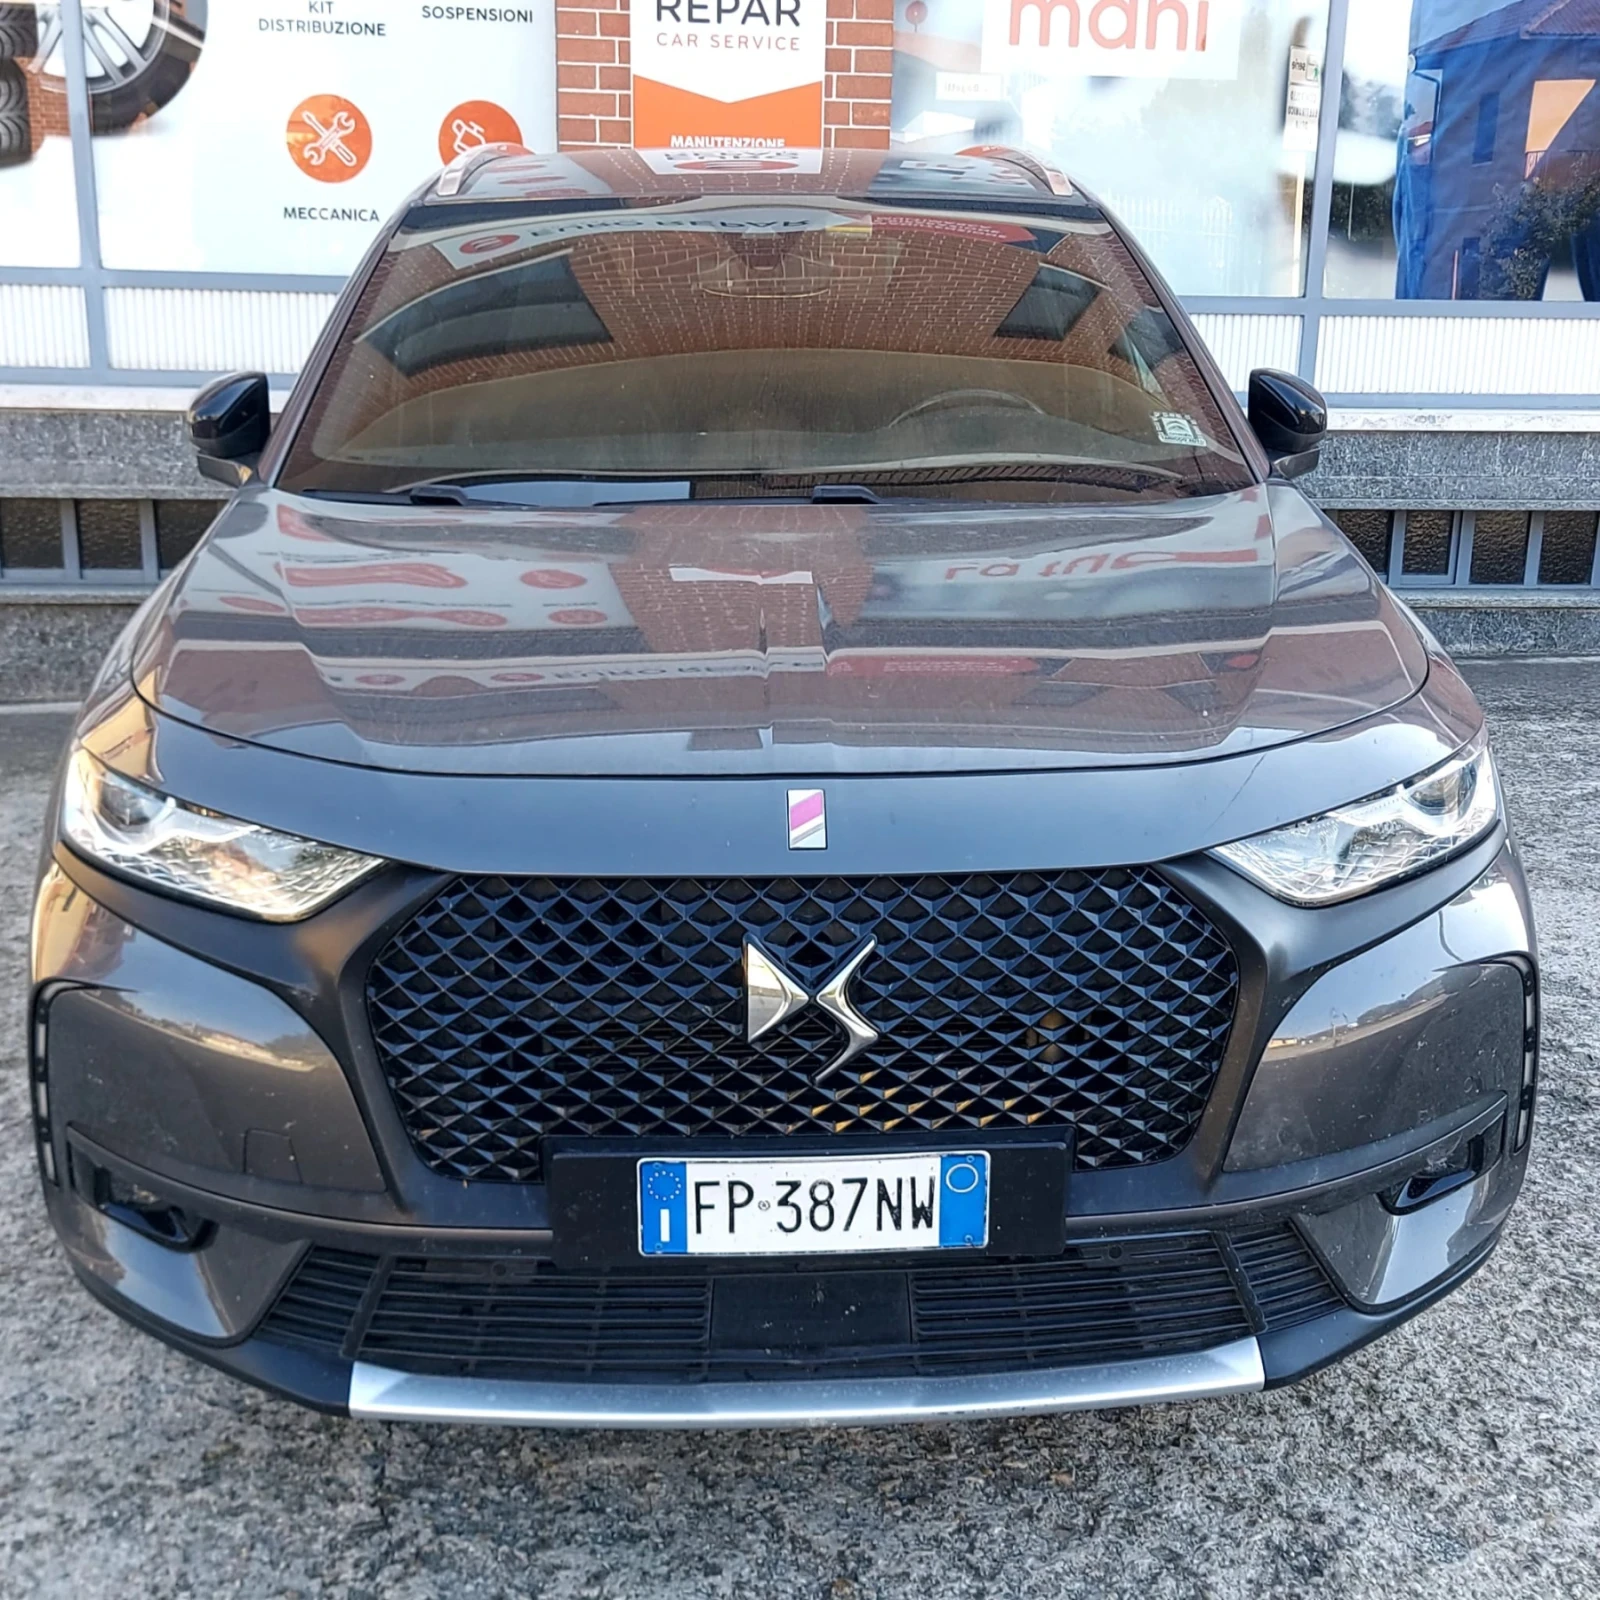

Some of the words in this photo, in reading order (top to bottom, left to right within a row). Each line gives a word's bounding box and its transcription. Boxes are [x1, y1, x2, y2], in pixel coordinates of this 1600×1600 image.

[308, 0, 334, 14] KIT
[421, 5, 533, 23] SOSPENSIONI
[656, 0, 801, 27] REPAR
[258, 18, 386, 36] DISTRIBUZIONE
[1009, 0, 1209, 52] mani
[656, 32, 698, 48] CAR
[710, 34, 800, 51] SERVICE
[670, 134, 786, 148] MANUTENZIONE
[283, 206, 380, 222] MECCANICA
